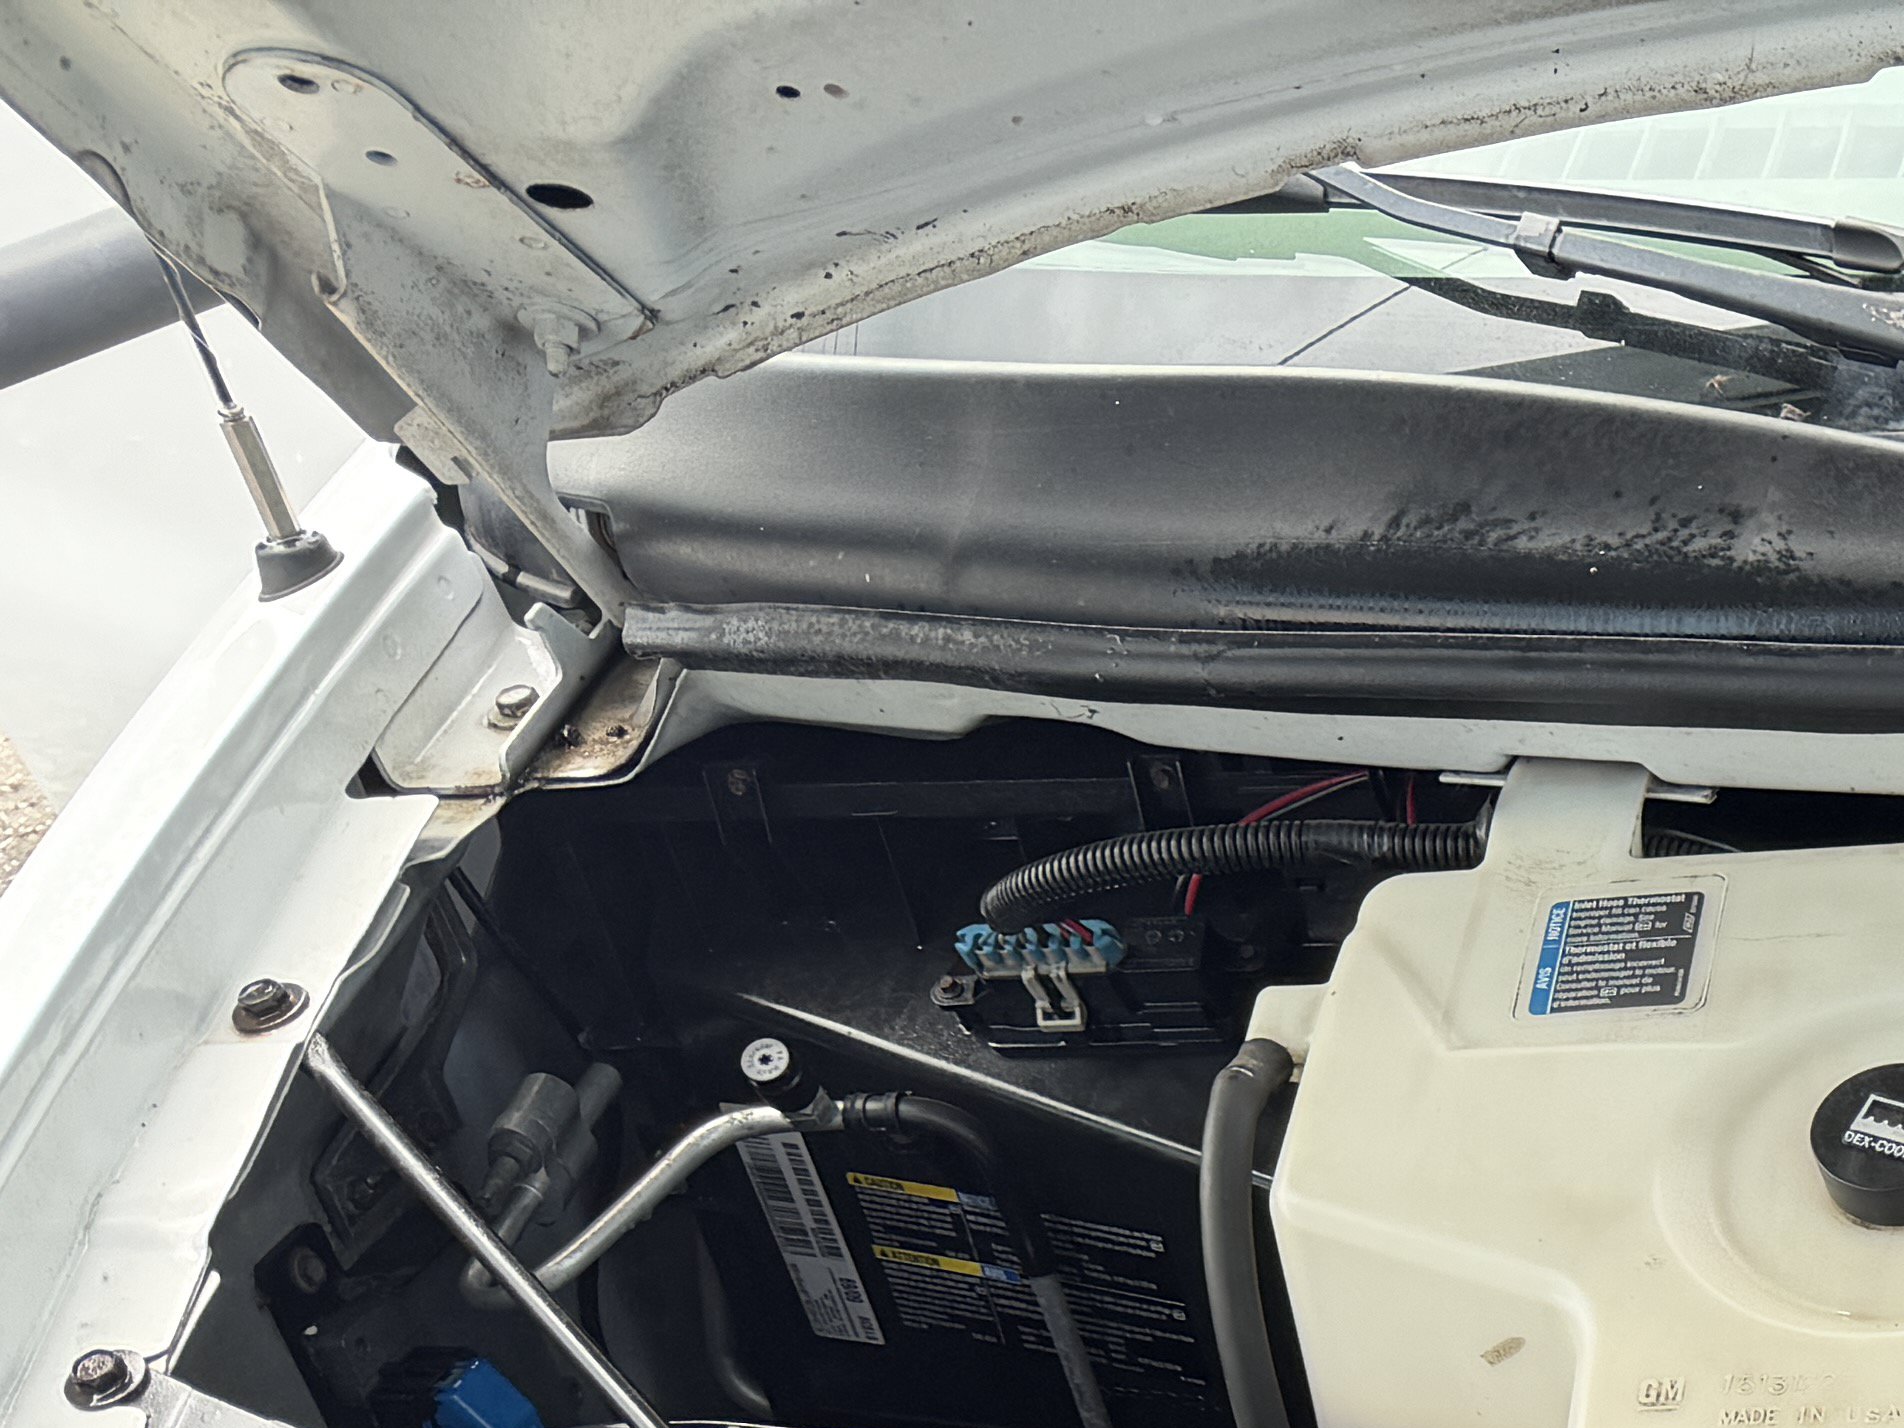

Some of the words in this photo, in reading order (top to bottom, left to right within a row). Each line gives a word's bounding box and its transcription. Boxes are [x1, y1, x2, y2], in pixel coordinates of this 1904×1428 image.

[1627, 894, 1686, 906] Thermostat
[1547, 907, 1566, 940] NOTICE
[1564, 941, 1623, 955] Thermostat
[1625, 941, 1637, 950] et
[1638, 938, 1678, 950] flexible
[1535, 967, 1552, 989] AVIS
[1638, 1376, 1686, 1406] GM
[1720, 1407, 1781, 1426] MADE
[1797, 1406, 1828, 1425] IN
[1847, 1404, 1901, 1425] USA
